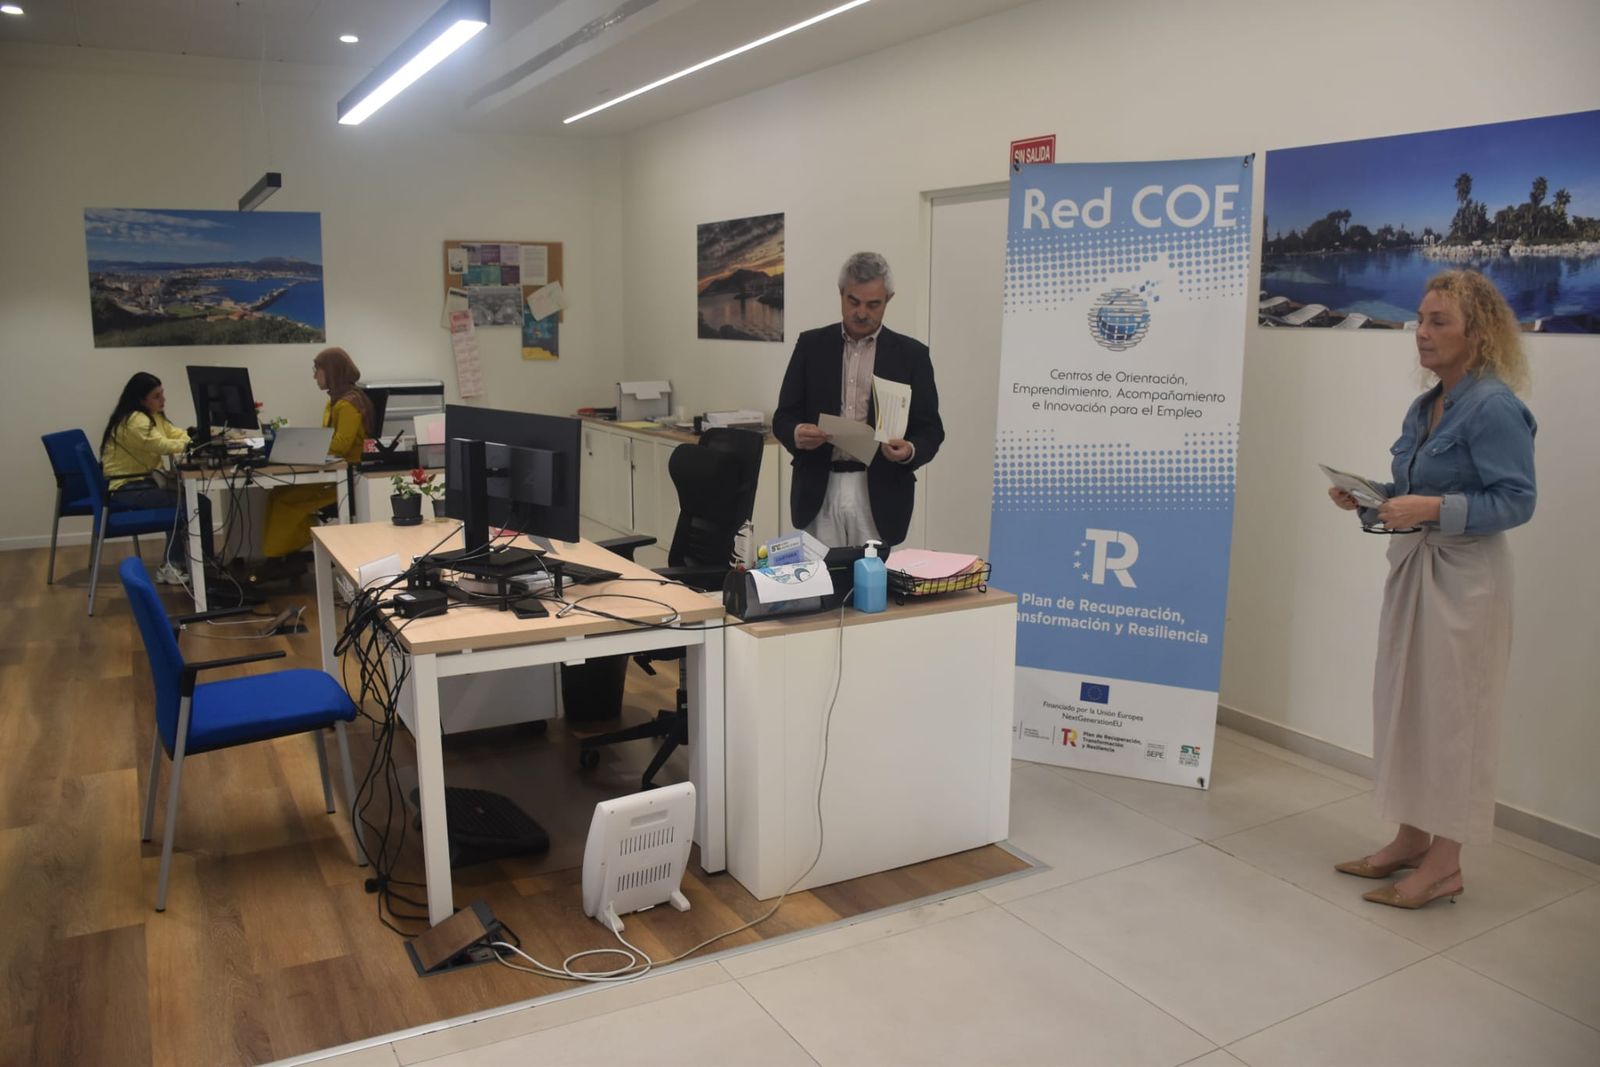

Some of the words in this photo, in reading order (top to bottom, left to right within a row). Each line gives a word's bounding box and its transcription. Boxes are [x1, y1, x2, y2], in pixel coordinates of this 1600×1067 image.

[1014, 149, 1025, 163] SIN
[1026, 145, 1050, 163] SALIDA
[1023, 186, 1112, 229] Red
[1132, 184, 1239, 228] COE
[1050, 368, 1093, 382] Centros
[1096, 370, 1112, 382] de
[1115, 370, 1188, 386] Orientación,
[1012, 382, 1112, 398] Emprendimiento,
[1116, 387, 1226, 403] Acompañamiento
[1032, 402, 1040, 410] e
[1044, 400, 1106, 414] Innovación
[1110, 405, 1138, 417] para
[1141, 404, 1153, 416] el
[1157, 405, 1203, 420] Empleo
[1022, 592, 1052, 608] Plan
[1056, 596, 1075, 610] de
[1079, 599, 1185, 625] Recuperación,
[1016, 611, 1110, 632] ansformación
[1115, 624, 1124, 635] y
[1128, 622, 1209, 644] Resiliencia
[1043, 701, 1075, 712] Financiado
[1097, 709, 1116, 717] Unión
[1062, 713, 1123, 727] NextGenerationEU
